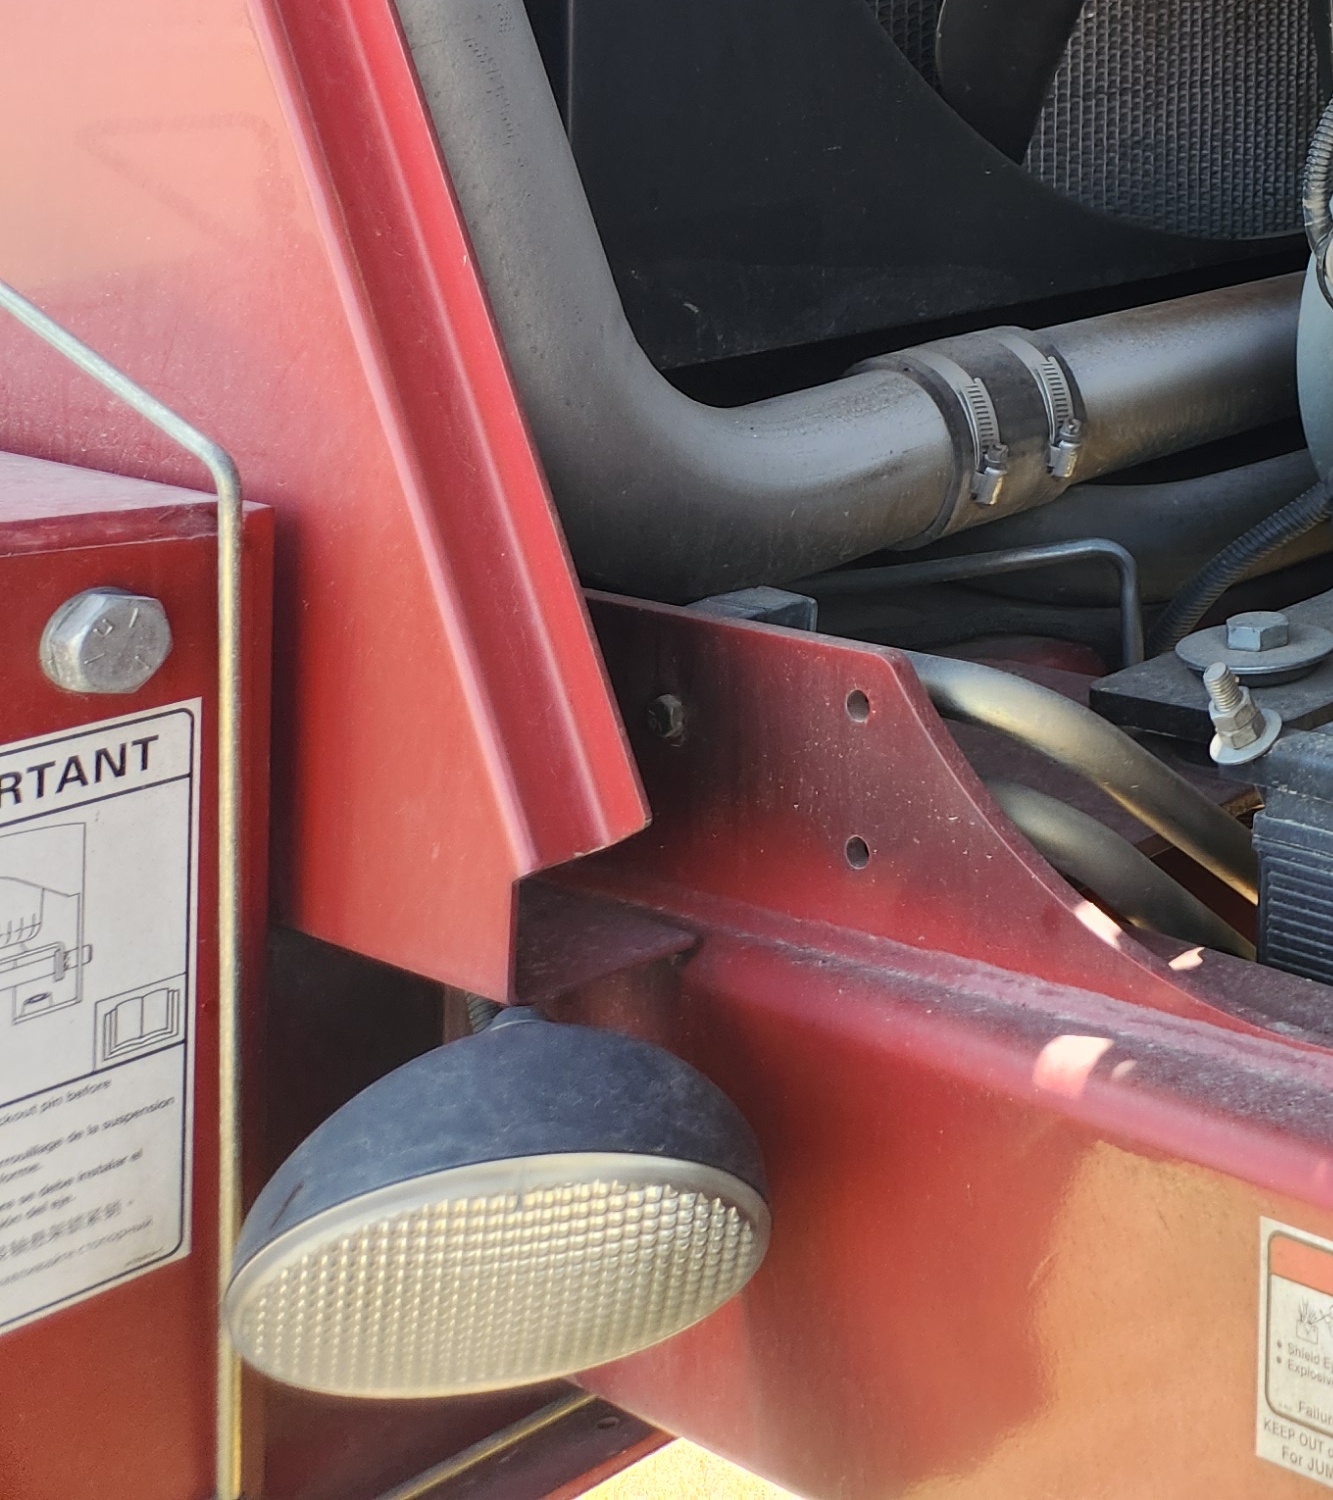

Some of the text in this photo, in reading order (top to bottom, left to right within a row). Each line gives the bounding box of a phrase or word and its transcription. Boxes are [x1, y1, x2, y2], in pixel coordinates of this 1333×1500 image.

[0, 734, 159, 808] RTANT
[66, 1079, 112, 1103] before
[66, 1129, 85, 1144] de
[102, 1096, 176, 1131] suspension
[1288, 1342, 1320, 1365] Shield
[1263, 1416, 1296, 1440] KEEP
[1299, 1432, 1325, 1451] OUT
[1282, 1445, 1303, 1466] For
